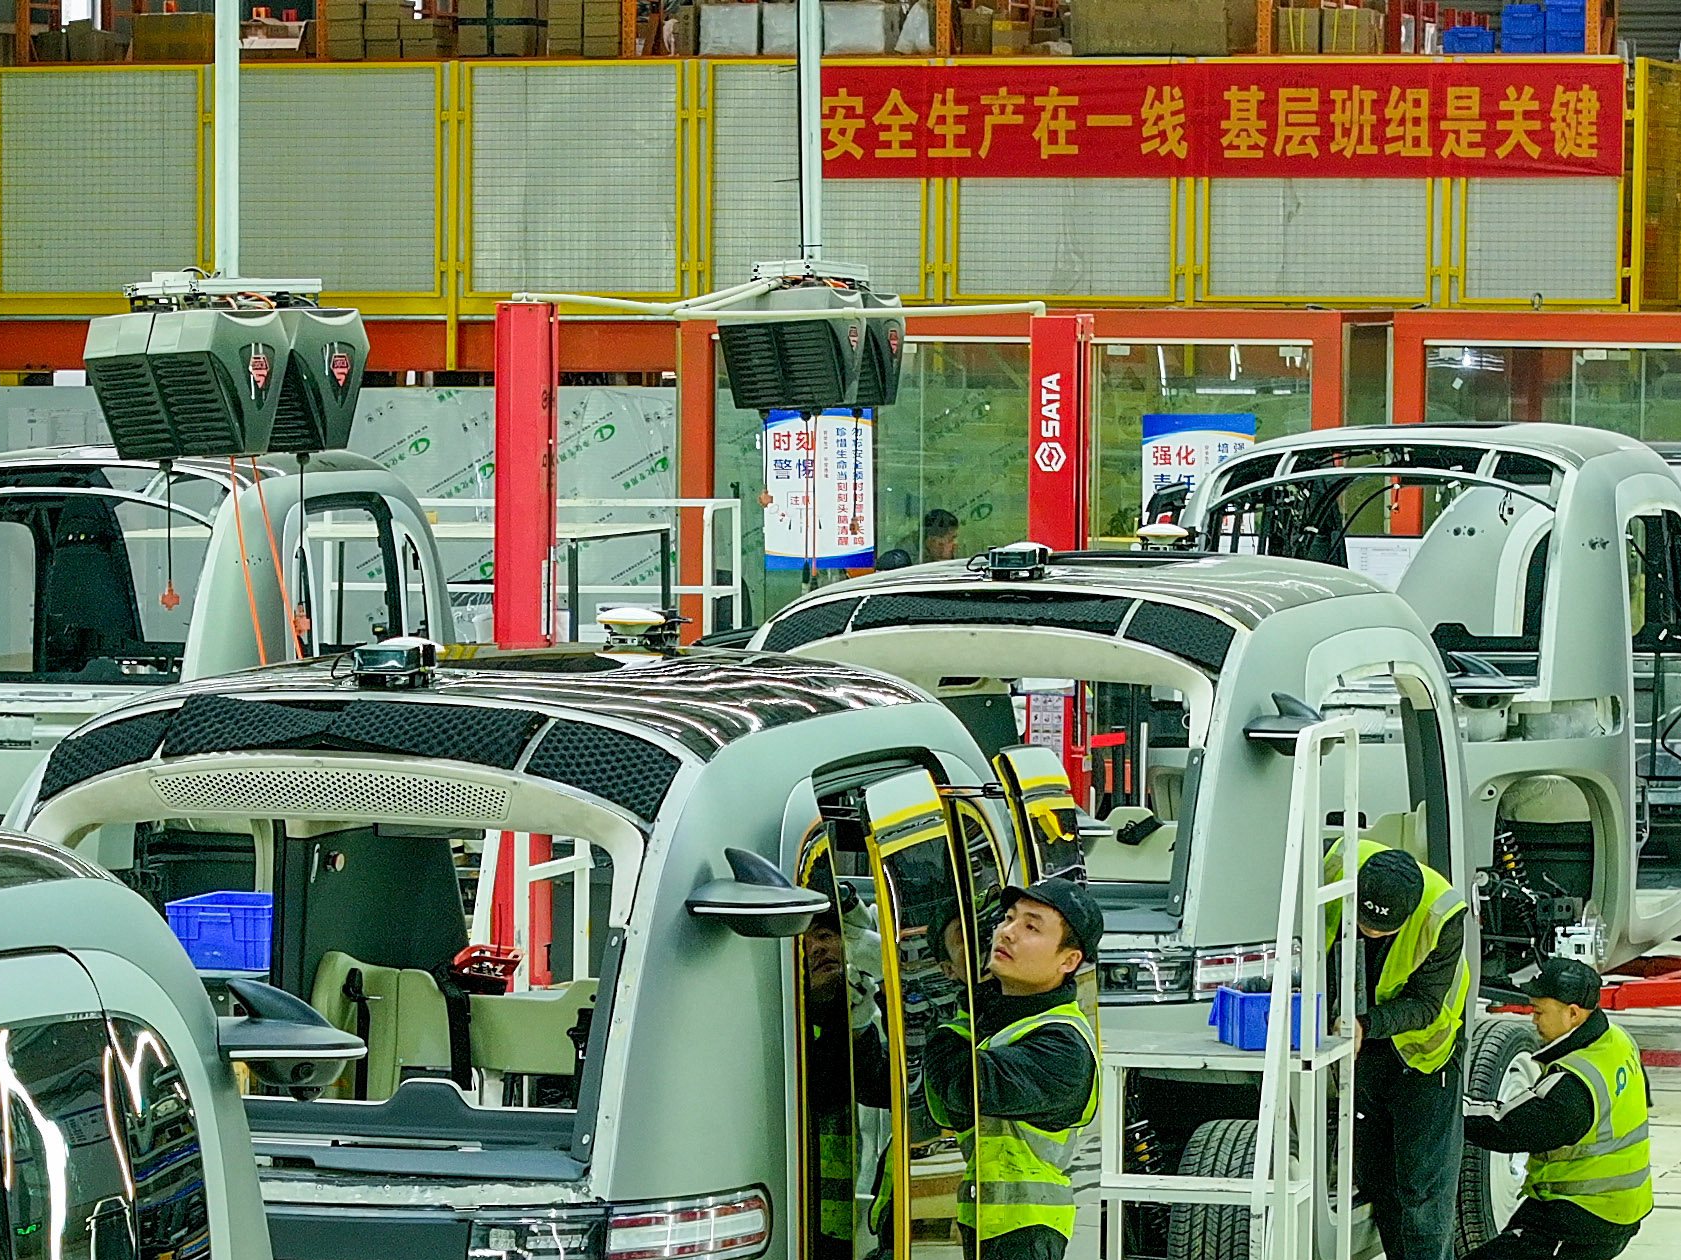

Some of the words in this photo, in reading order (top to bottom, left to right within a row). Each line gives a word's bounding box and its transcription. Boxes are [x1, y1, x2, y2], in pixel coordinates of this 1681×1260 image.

[820, 85, 1189, 160] 安全生产在一线
[1219, 83, 1601, 160] 基层班组是关键
[1041, 372, 1061, 438] SATA
[772, 430, 817, 452] 时刻
[1152, 445, 1196, 466] 强化
[772, 458, 816, 480] 警惕
[1152, 473, 1196, 494] 责任
